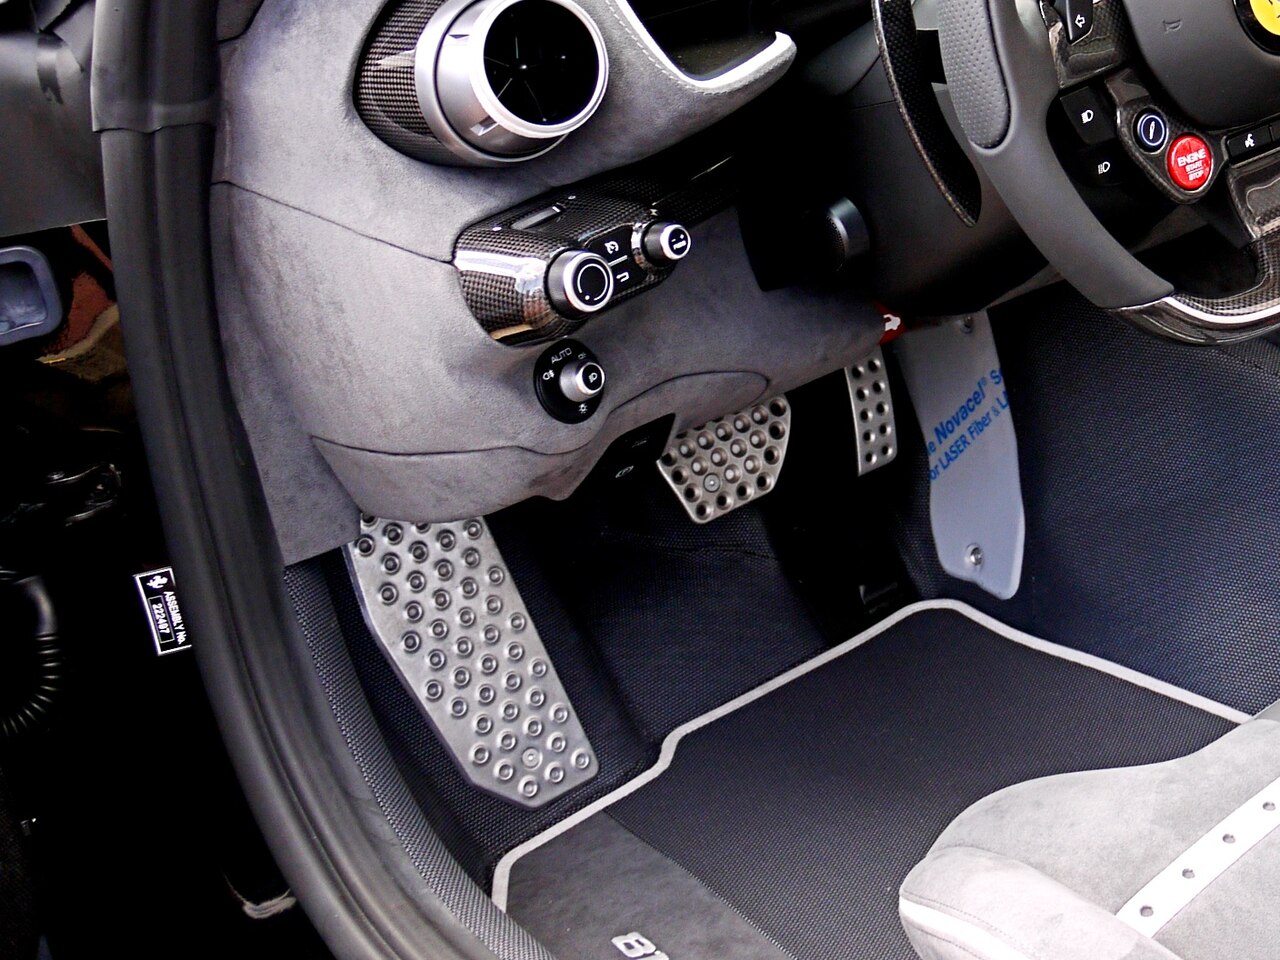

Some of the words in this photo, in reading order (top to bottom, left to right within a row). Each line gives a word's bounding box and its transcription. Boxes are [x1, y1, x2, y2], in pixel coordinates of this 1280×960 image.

[1177, 148, 1207, 168] ENGINE
[1185, 159, 1204, 172] START
[1188, 169, 1205, 181] STOP
[551, 347, 572, 365] AUTO
[938, 433, 972, 471] LASER
[967, 411, 993, 441] Fiber
[163, 591, 186, 631] ASSEMBLY
